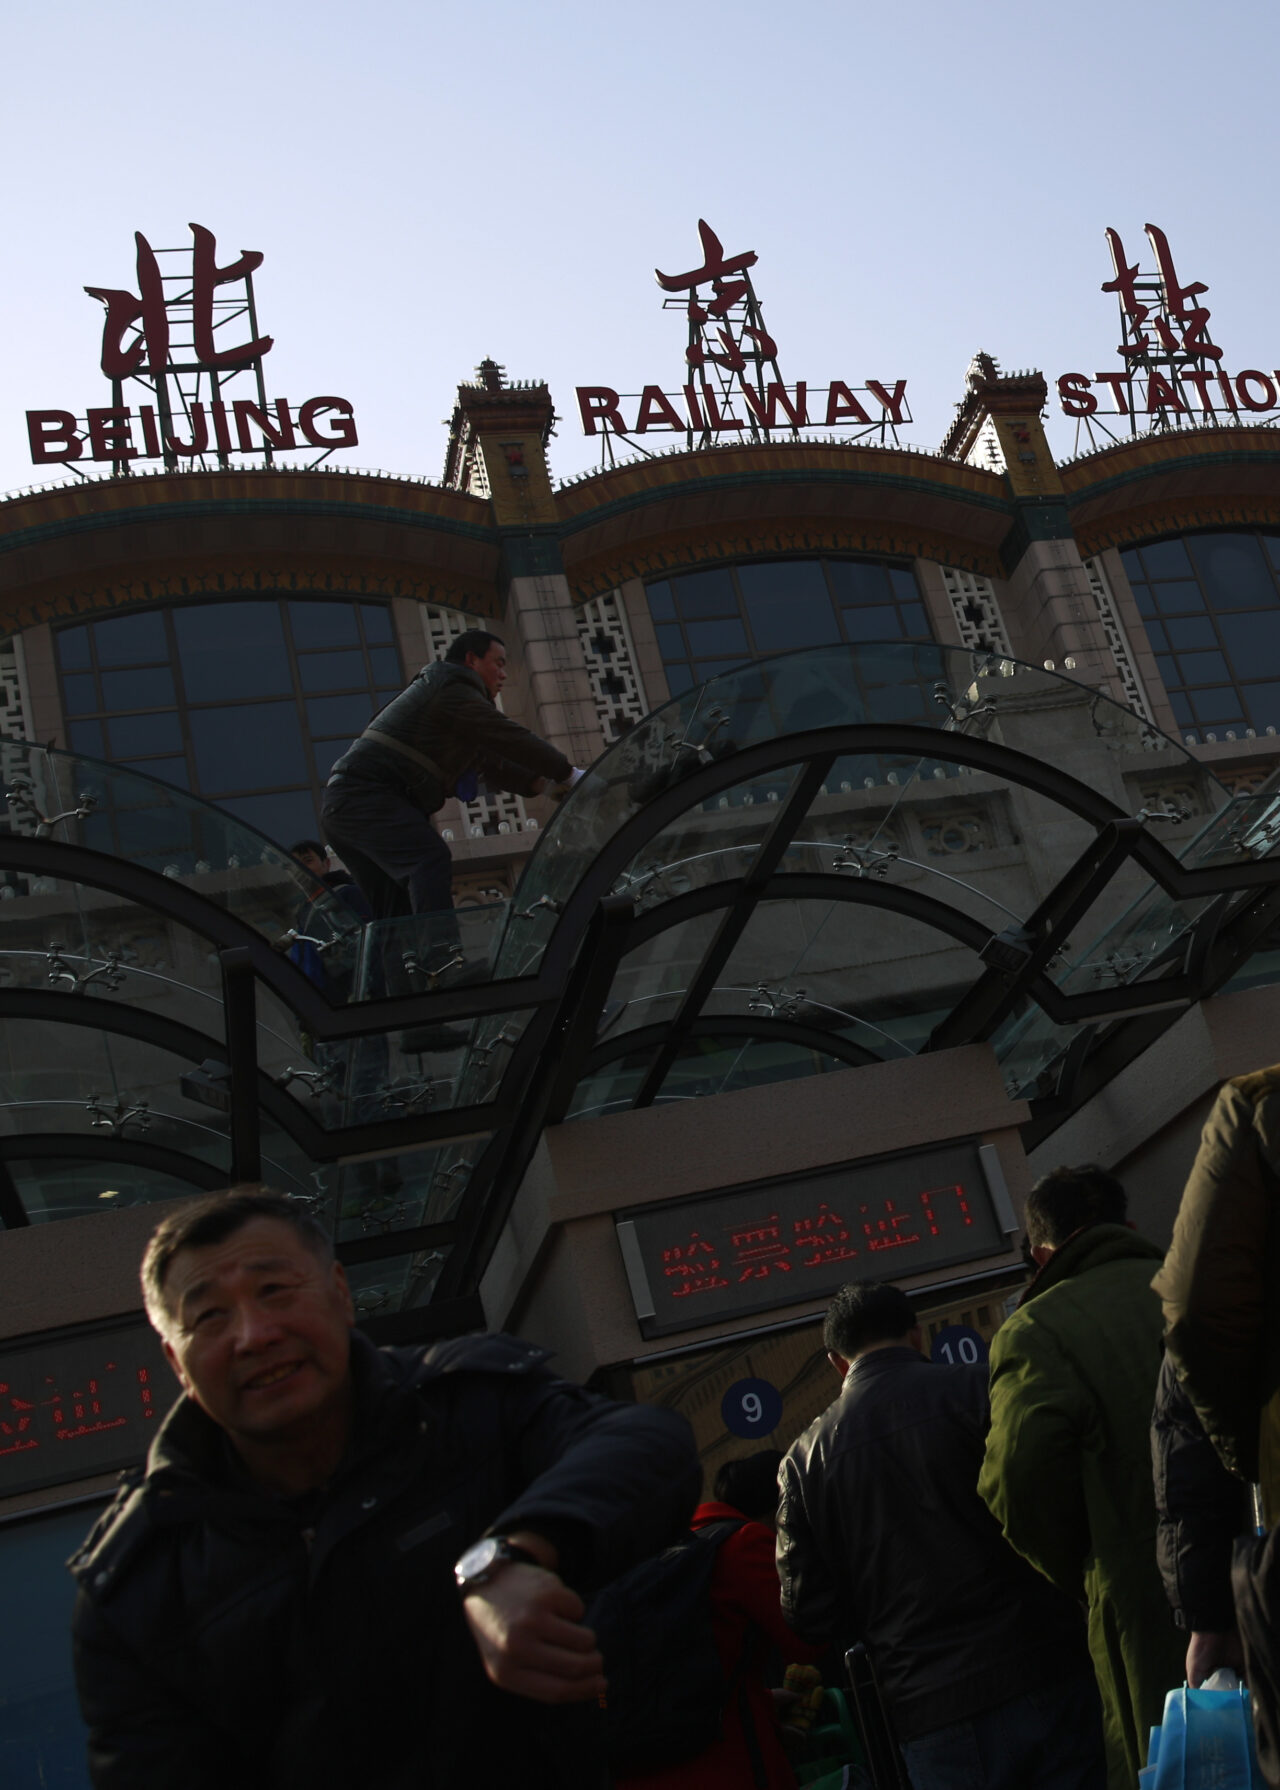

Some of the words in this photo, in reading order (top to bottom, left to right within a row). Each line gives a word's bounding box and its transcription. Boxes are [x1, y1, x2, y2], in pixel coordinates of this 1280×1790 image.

[83, 222, 274, 381] 北
[655, 218, 778, 372] 京
[1100, 222, 1224, 361] 站
[26, 396, 358, 465] BEIJING
[575, 379, 908, 436] RAILWAY
[940, 1336, 979, 1364] 10
[741, 1392, 763, 1424] 9
